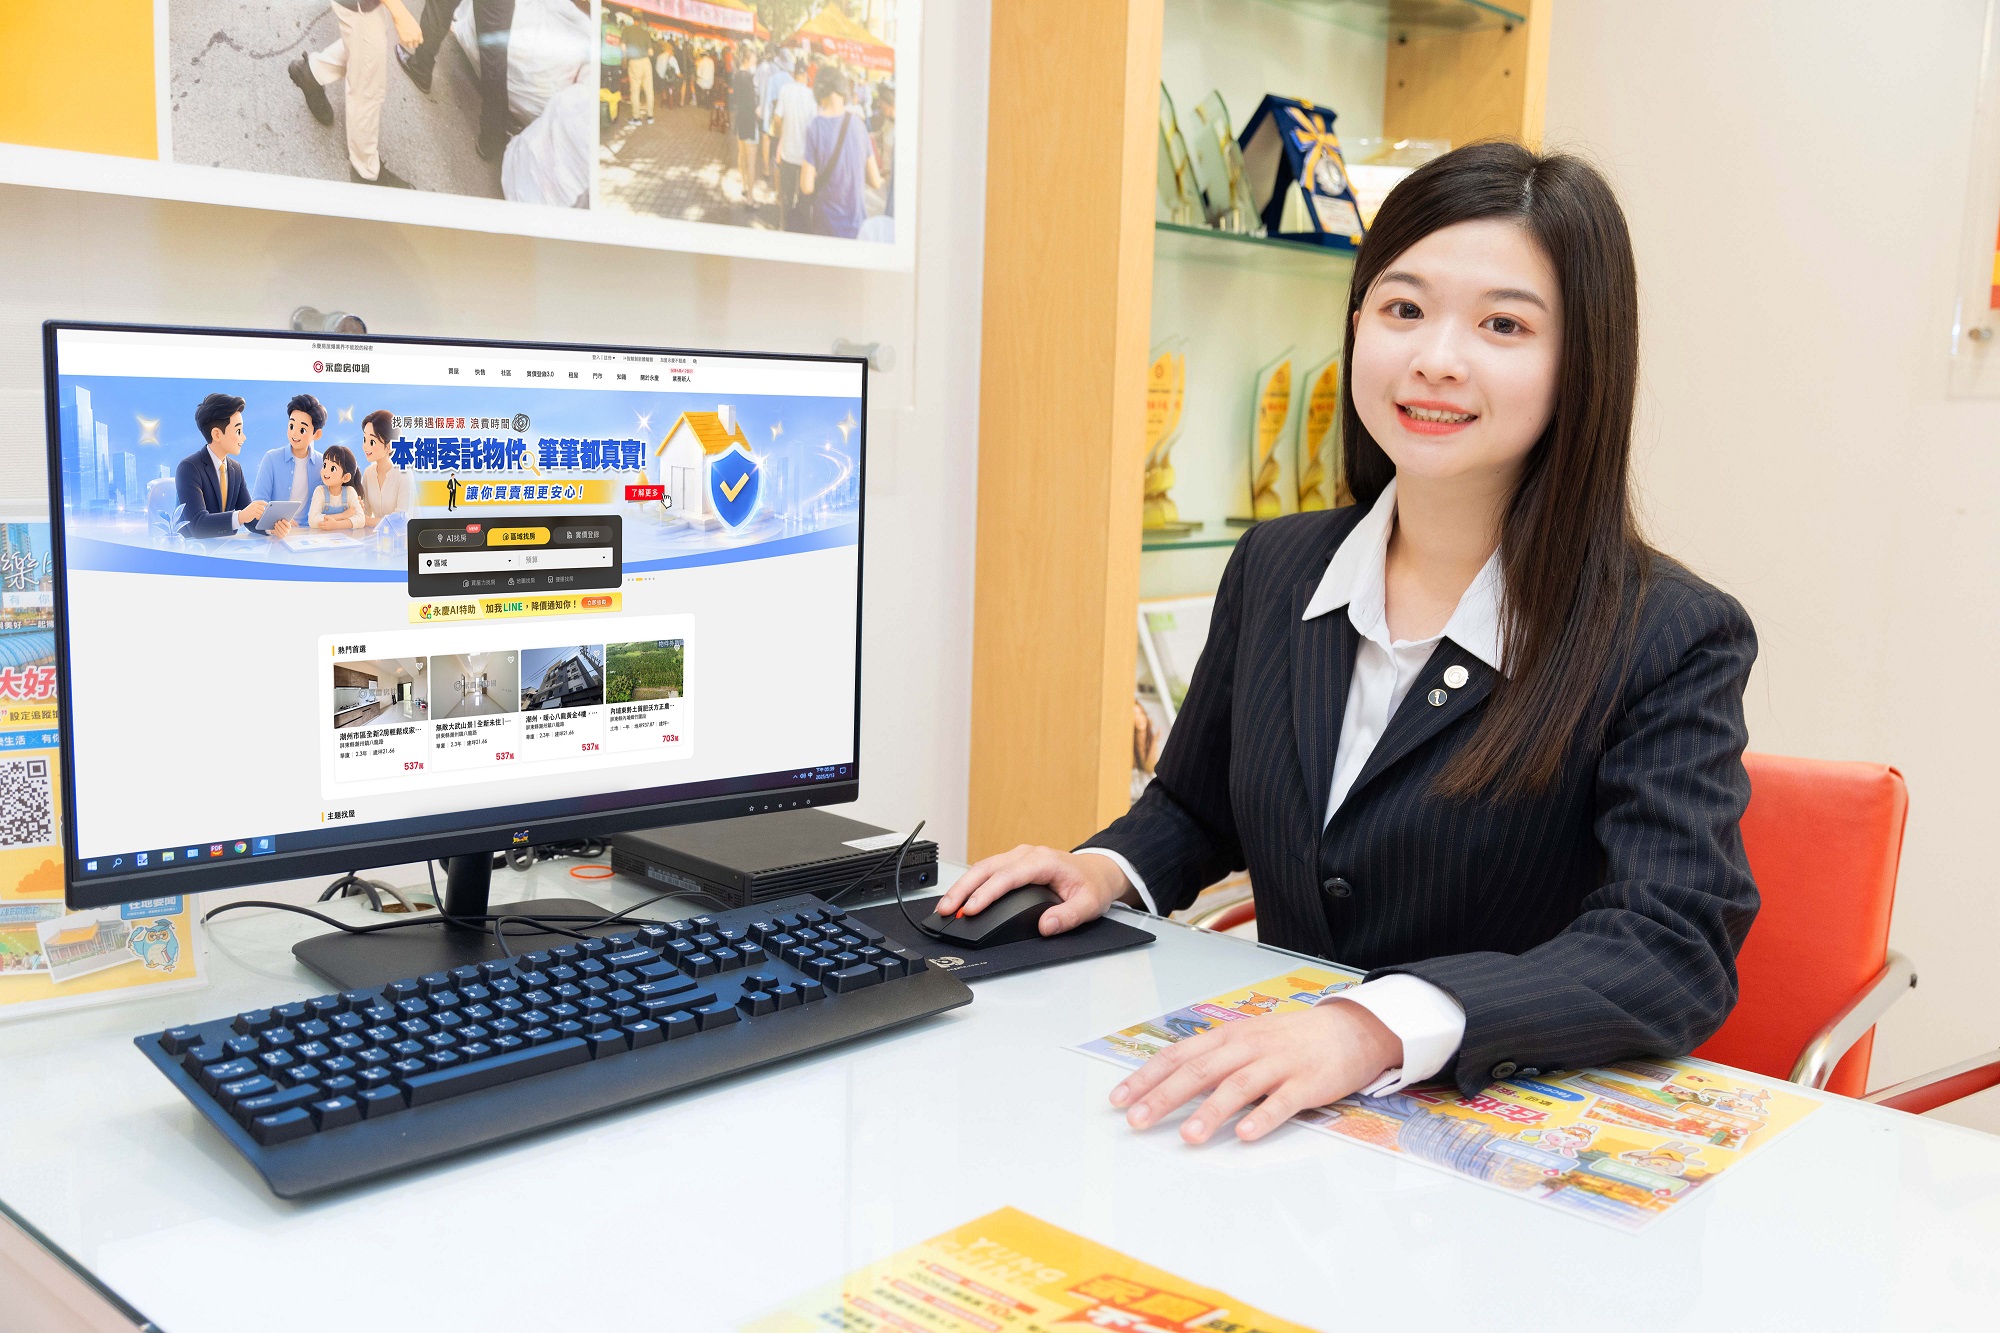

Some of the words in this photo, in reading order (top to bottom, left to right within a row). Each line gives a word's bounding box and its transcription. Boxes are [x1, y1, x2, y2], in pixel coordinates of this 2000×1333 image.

[325, 363, 370, 373] 永慶房仲網
[501, 369, 512, 377] 社區
[392, 416, 466, 429] 找房頻遇假房源
[470, 417, 510, 430] 浪費時間
[390, 436, 528, 471] 本網委託物件
[537, 437, 647, 470] 筆筆都真實!
[631, 488, 659, 497] 了解更多
[446, 534, 467, 543] AI找房
[510, 531, 536, 541] 區域找房
[434, 559, 448, 567] 區域
[433, 605, 476, 616] 永慶AI特助
[338, 645, 367, 654] 熱門首選
[327, 810, 356, 820] 主題找屋
[210, 844, 223, 852] PDF
